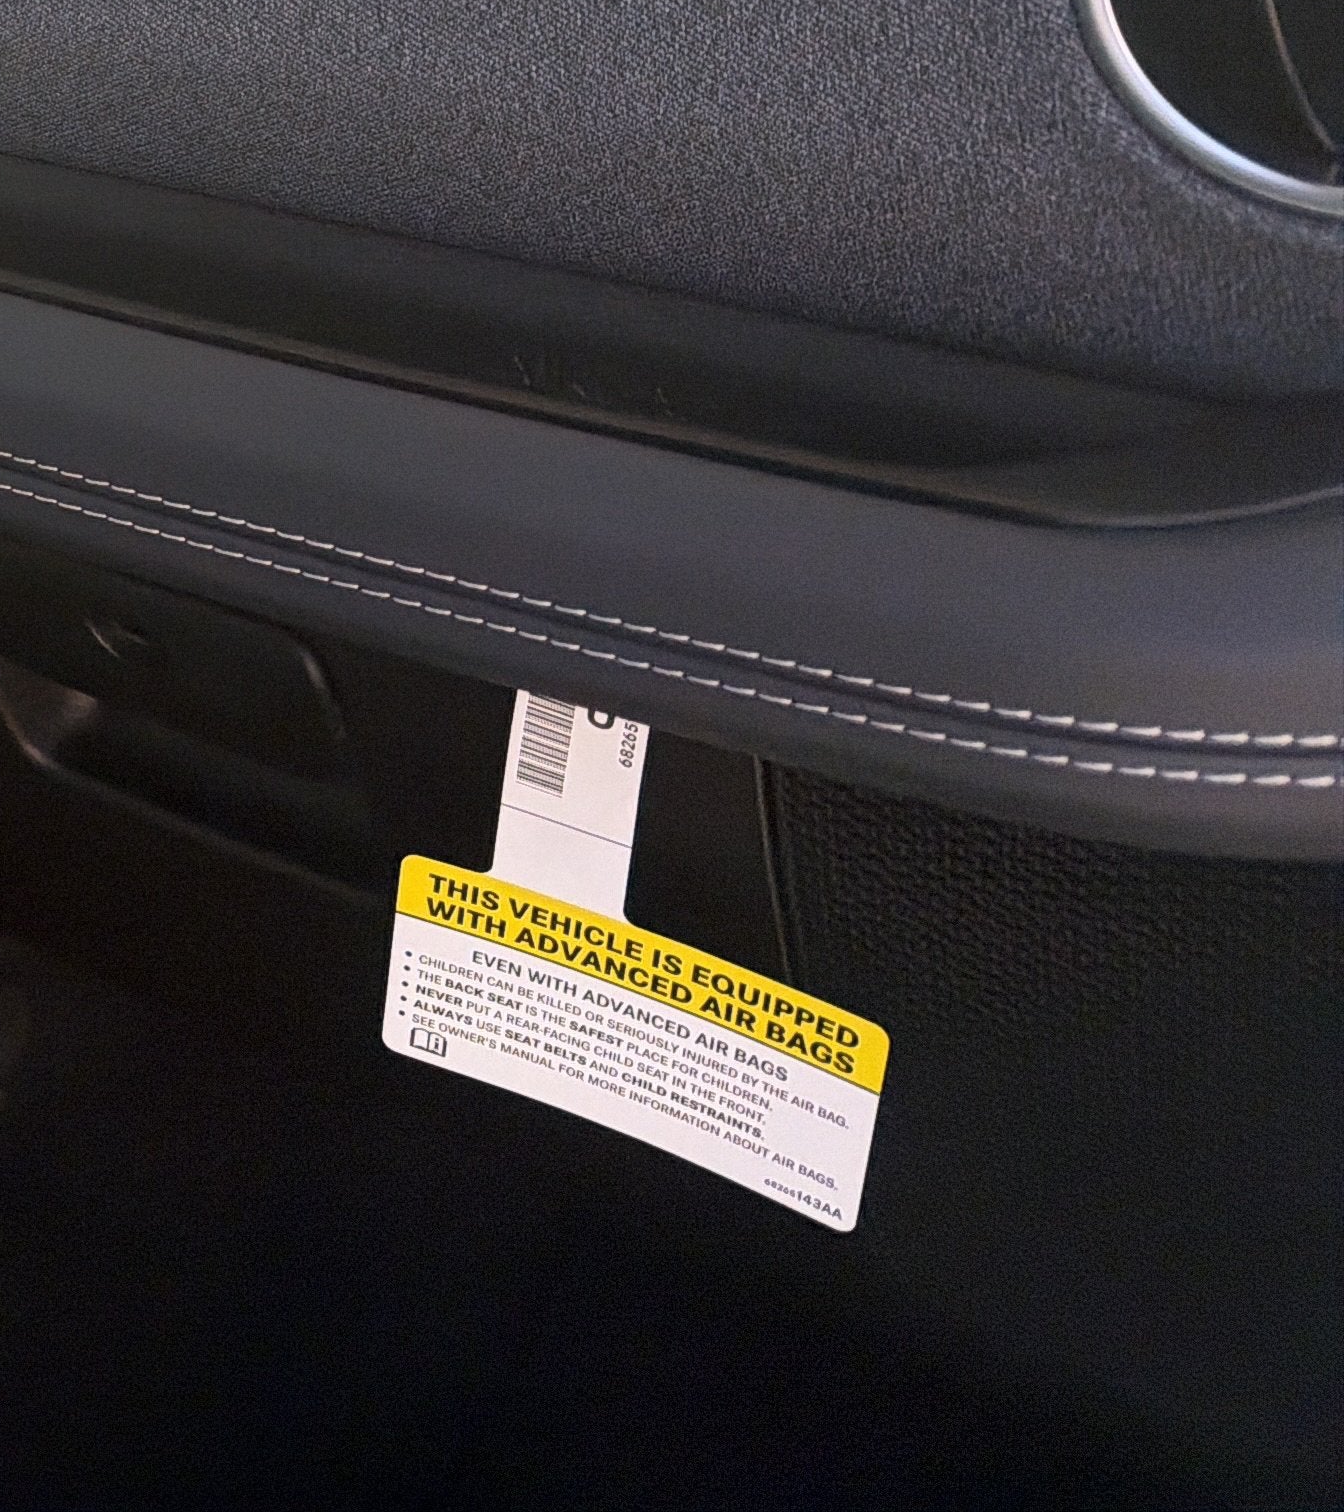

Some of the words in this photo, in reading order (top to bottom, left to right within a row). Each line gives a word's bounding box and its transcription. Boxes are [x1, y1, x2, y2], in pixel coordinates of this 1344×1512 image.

[618, 721, 639, 769] 68265
[426, 896, 507, 939] WITH
[513, 926, 692, 1004] ADVANCED
[698, 995, 756, 1033] AIR
[764, 1019, 855, 1074] BAGS
[428, 872, 500, 911] THIS
[508, 897, 644, 962] VEHICLE
[650, 948, 683, 976] IS
[690, 963, 859, 1048] EQUIPPED
[471, 949, 522, 978] EVEN
[527, 967, 578, 997] WITH
[581, 988, 691, 1040] ADVANCED
[693, 1031, 729, 1057] AIR
[732, 1046, 788, 1082] BAGS
[410, 1012, 435, 1029] SEE
[437, 1021, 497, 1050] OWNER'S
[499, 1041, 555, 1070] MANUAL
[557, 1062, 585, 1081] FOR
[586, 1073, 626, 1098] MORE
[627, 1089, 721, 1137] INFORMATION
[722, 1130, 769, 1158] ABOUT
[770, 1152, 795, 1171] AIR
[797, 1163, 838, 1191] BAGS.
[412, 998, 473, 1026] ALWAYS
[475, 1017, 502, 1036] USE
[503, 1028, 541, 1049] SEAT
[542, 1041, 587, 1066] BELTS
[588, 1059, 619, 1078] AND
[620, 1071, 667, 1097] CHILD
[669, 1090, 764, 1140] RESTRAINTS.
[414, 983, 463, 1008] NEVER
[465, 999, 492, 1016] PUT
[492, 1009, 503, 1021] A
[505, 1012, 591, 1052] REAR-FACING
[592, 1044, 634, 1068] CHILD
[635, 1061, 670, 1082] SEAT
[670, 1074, 687, 1090] IN
[689, 1082, 716, 1102] THE
[717, 1094, 766, 1125] FRONT.
[416, 968, 442, 985] THE
[443, 977, 484, 999] BACK
[486, 991, 523, 1011] SEAT
[524, 1003, 538, 1017] IS
[540, 1008, 566, 1027] THE
[568, 1019, 624, 1048] SAFEST
[625, 1040, 669, 1066] PLACE
[670, 1058, 699, 1079] FOR
[700, 1071, 773, 1111] CHILDREN.
[417, 953, 484, 983] CHILDREN
[485, 975, 514, 993] CAN
[516, 985, 534, 1000] BE
[535, 991, 582, 1016] KILLED
[583, 1009, 604, 1026] OR
[606, 1017, 680, 1054] SERIOUSLY
[681, 1046, 739, 1079] INJURED
[740, 1071, 760, 1088] BY
[761, 1080, 789, 1102] THE
[789, 1094, 815, 1114] AIR
[816, 1105, 849, 1130] BAG.
